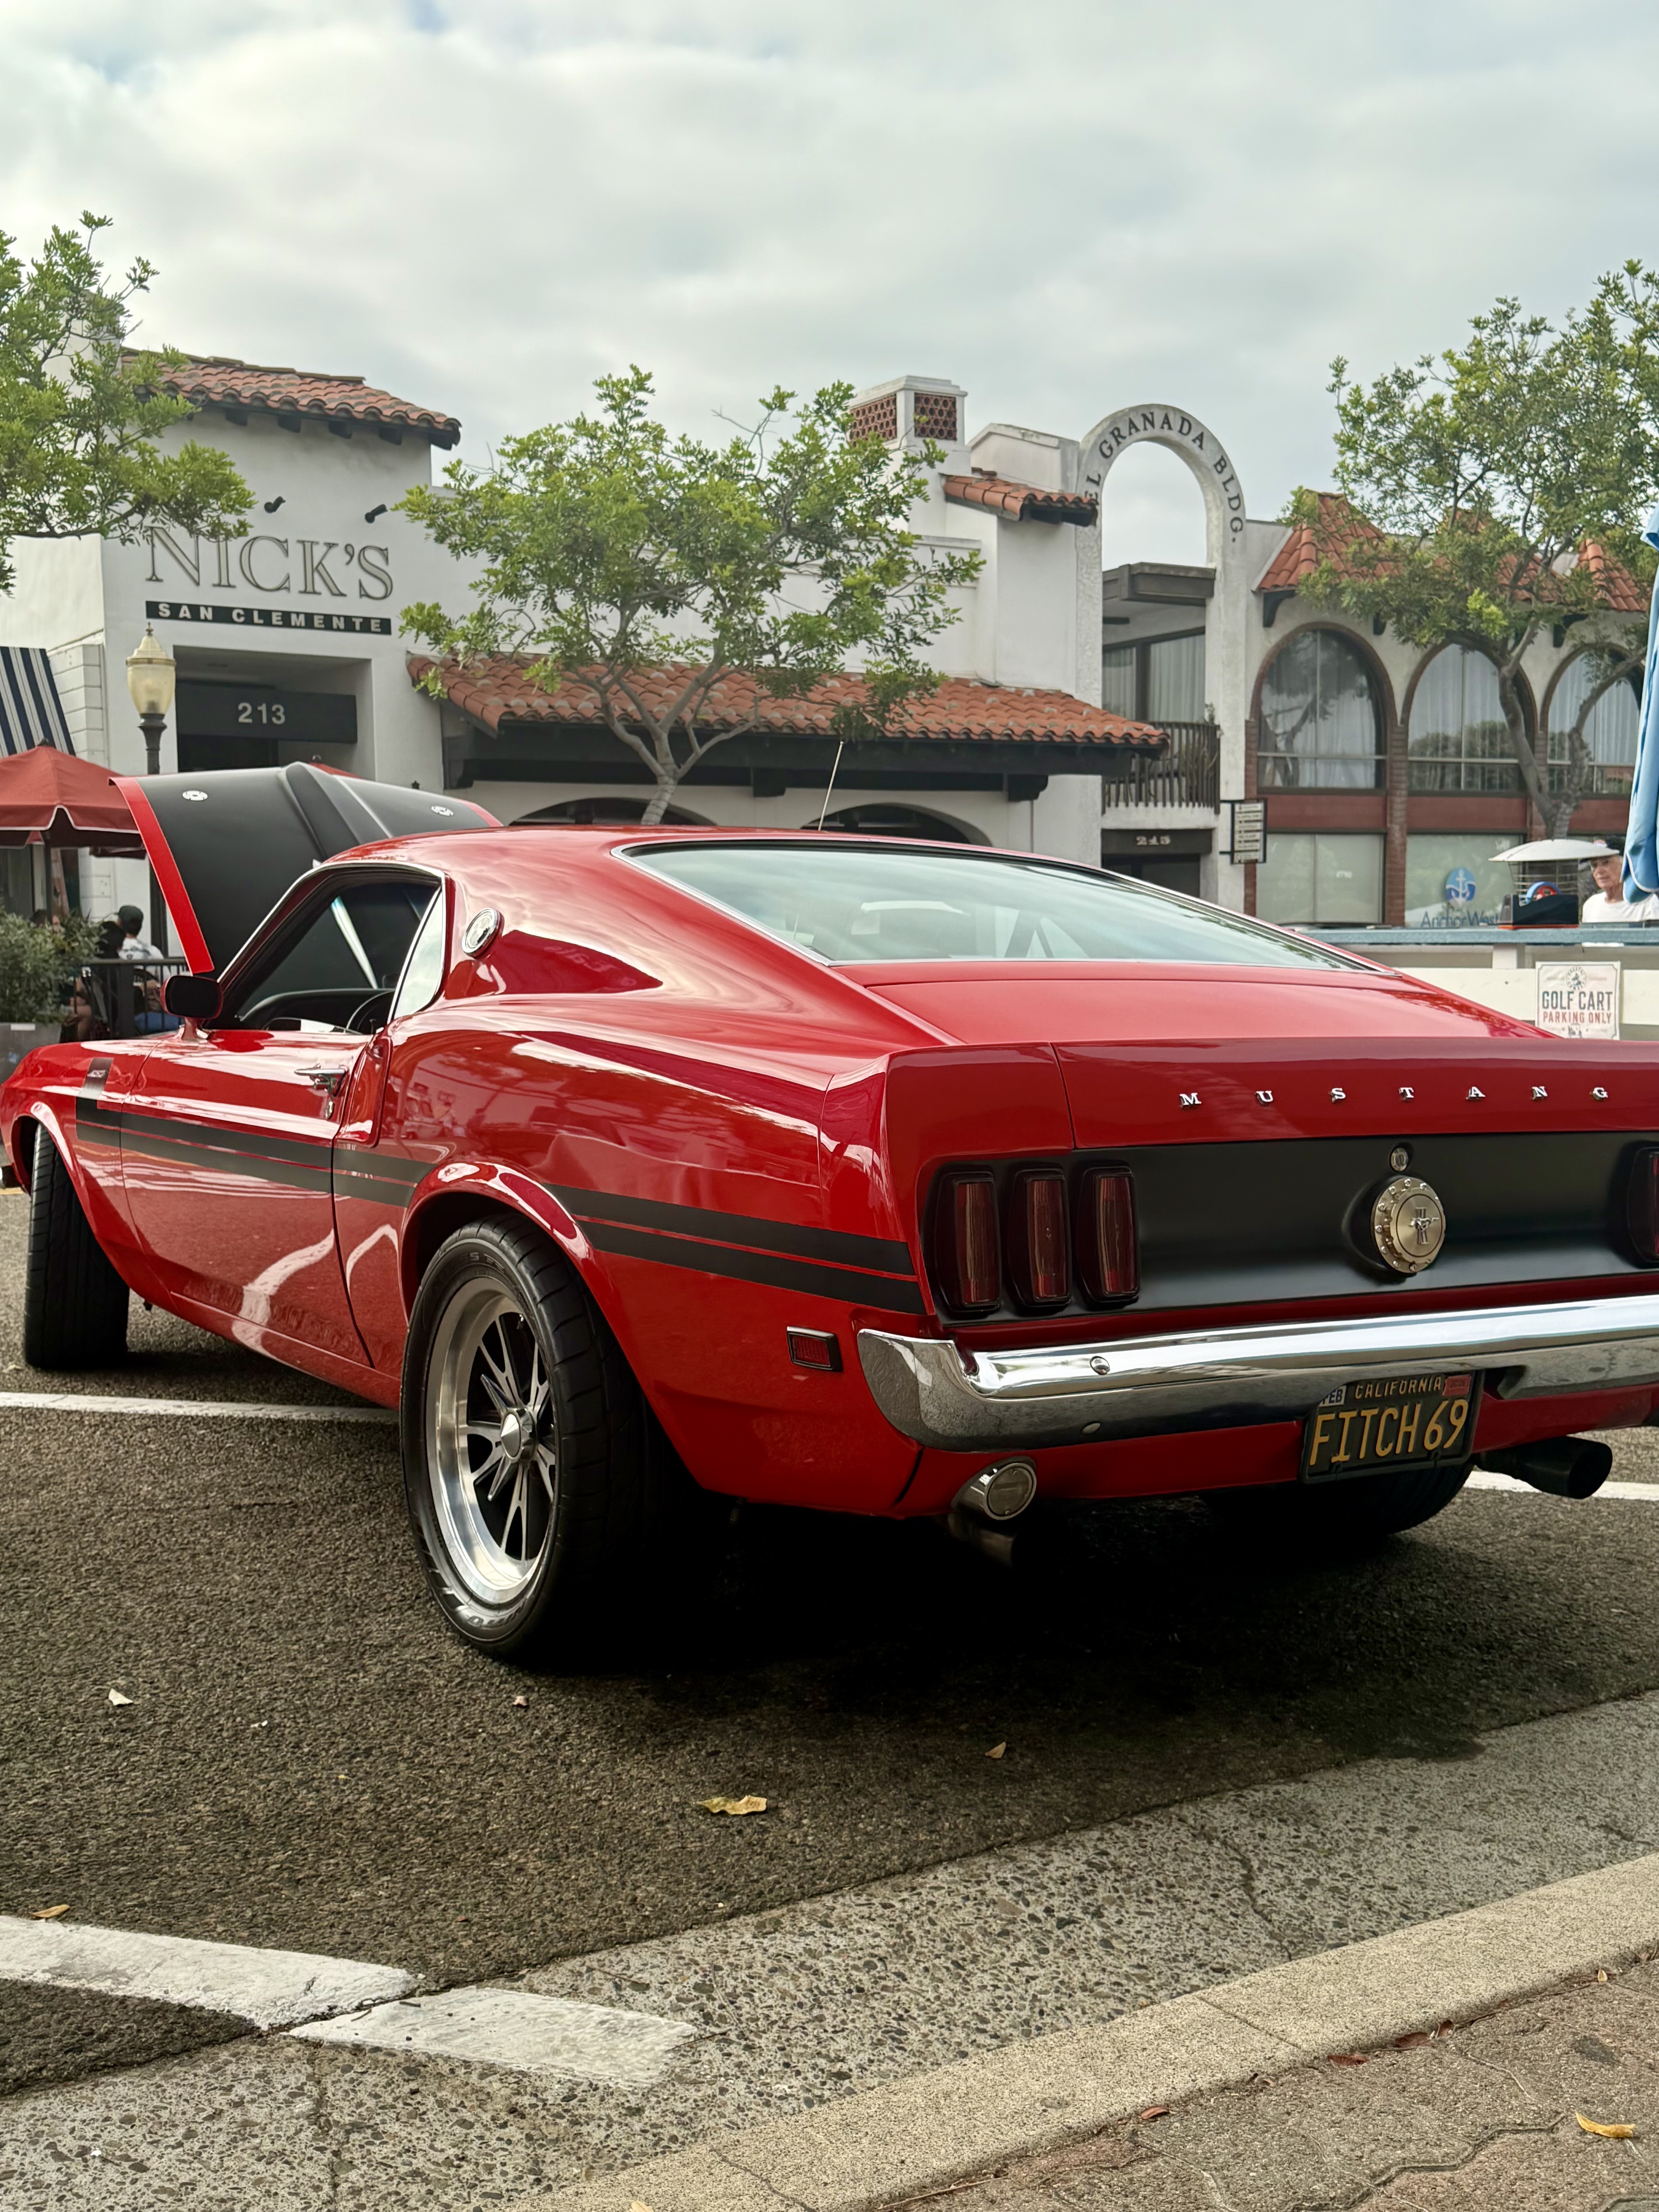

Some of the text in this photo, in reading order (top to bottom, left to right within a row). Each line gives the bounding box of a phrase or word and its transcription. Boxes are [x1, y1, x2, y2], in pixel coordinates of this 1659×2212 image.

[1099, 412, 1204, 459] GRANADA
[1213, 455, 1244, 543] BLDG.
[145, 525, 393, 601] NICK'S
[158, 602, 382, 633] SAN CLEMENTE
[237, 703, 286, 725] 213
[1542, 990, 1613, 1011] GOLF CART
[1543, 1011, 1612, 1024] PARKING ONLY
[1179, 1086, 1608, 1107] MUSTANG
[1355, 1376, 1441, 1399] CALIFORNIA
[1309, 1399, 1469, 1466] FITCH 69
